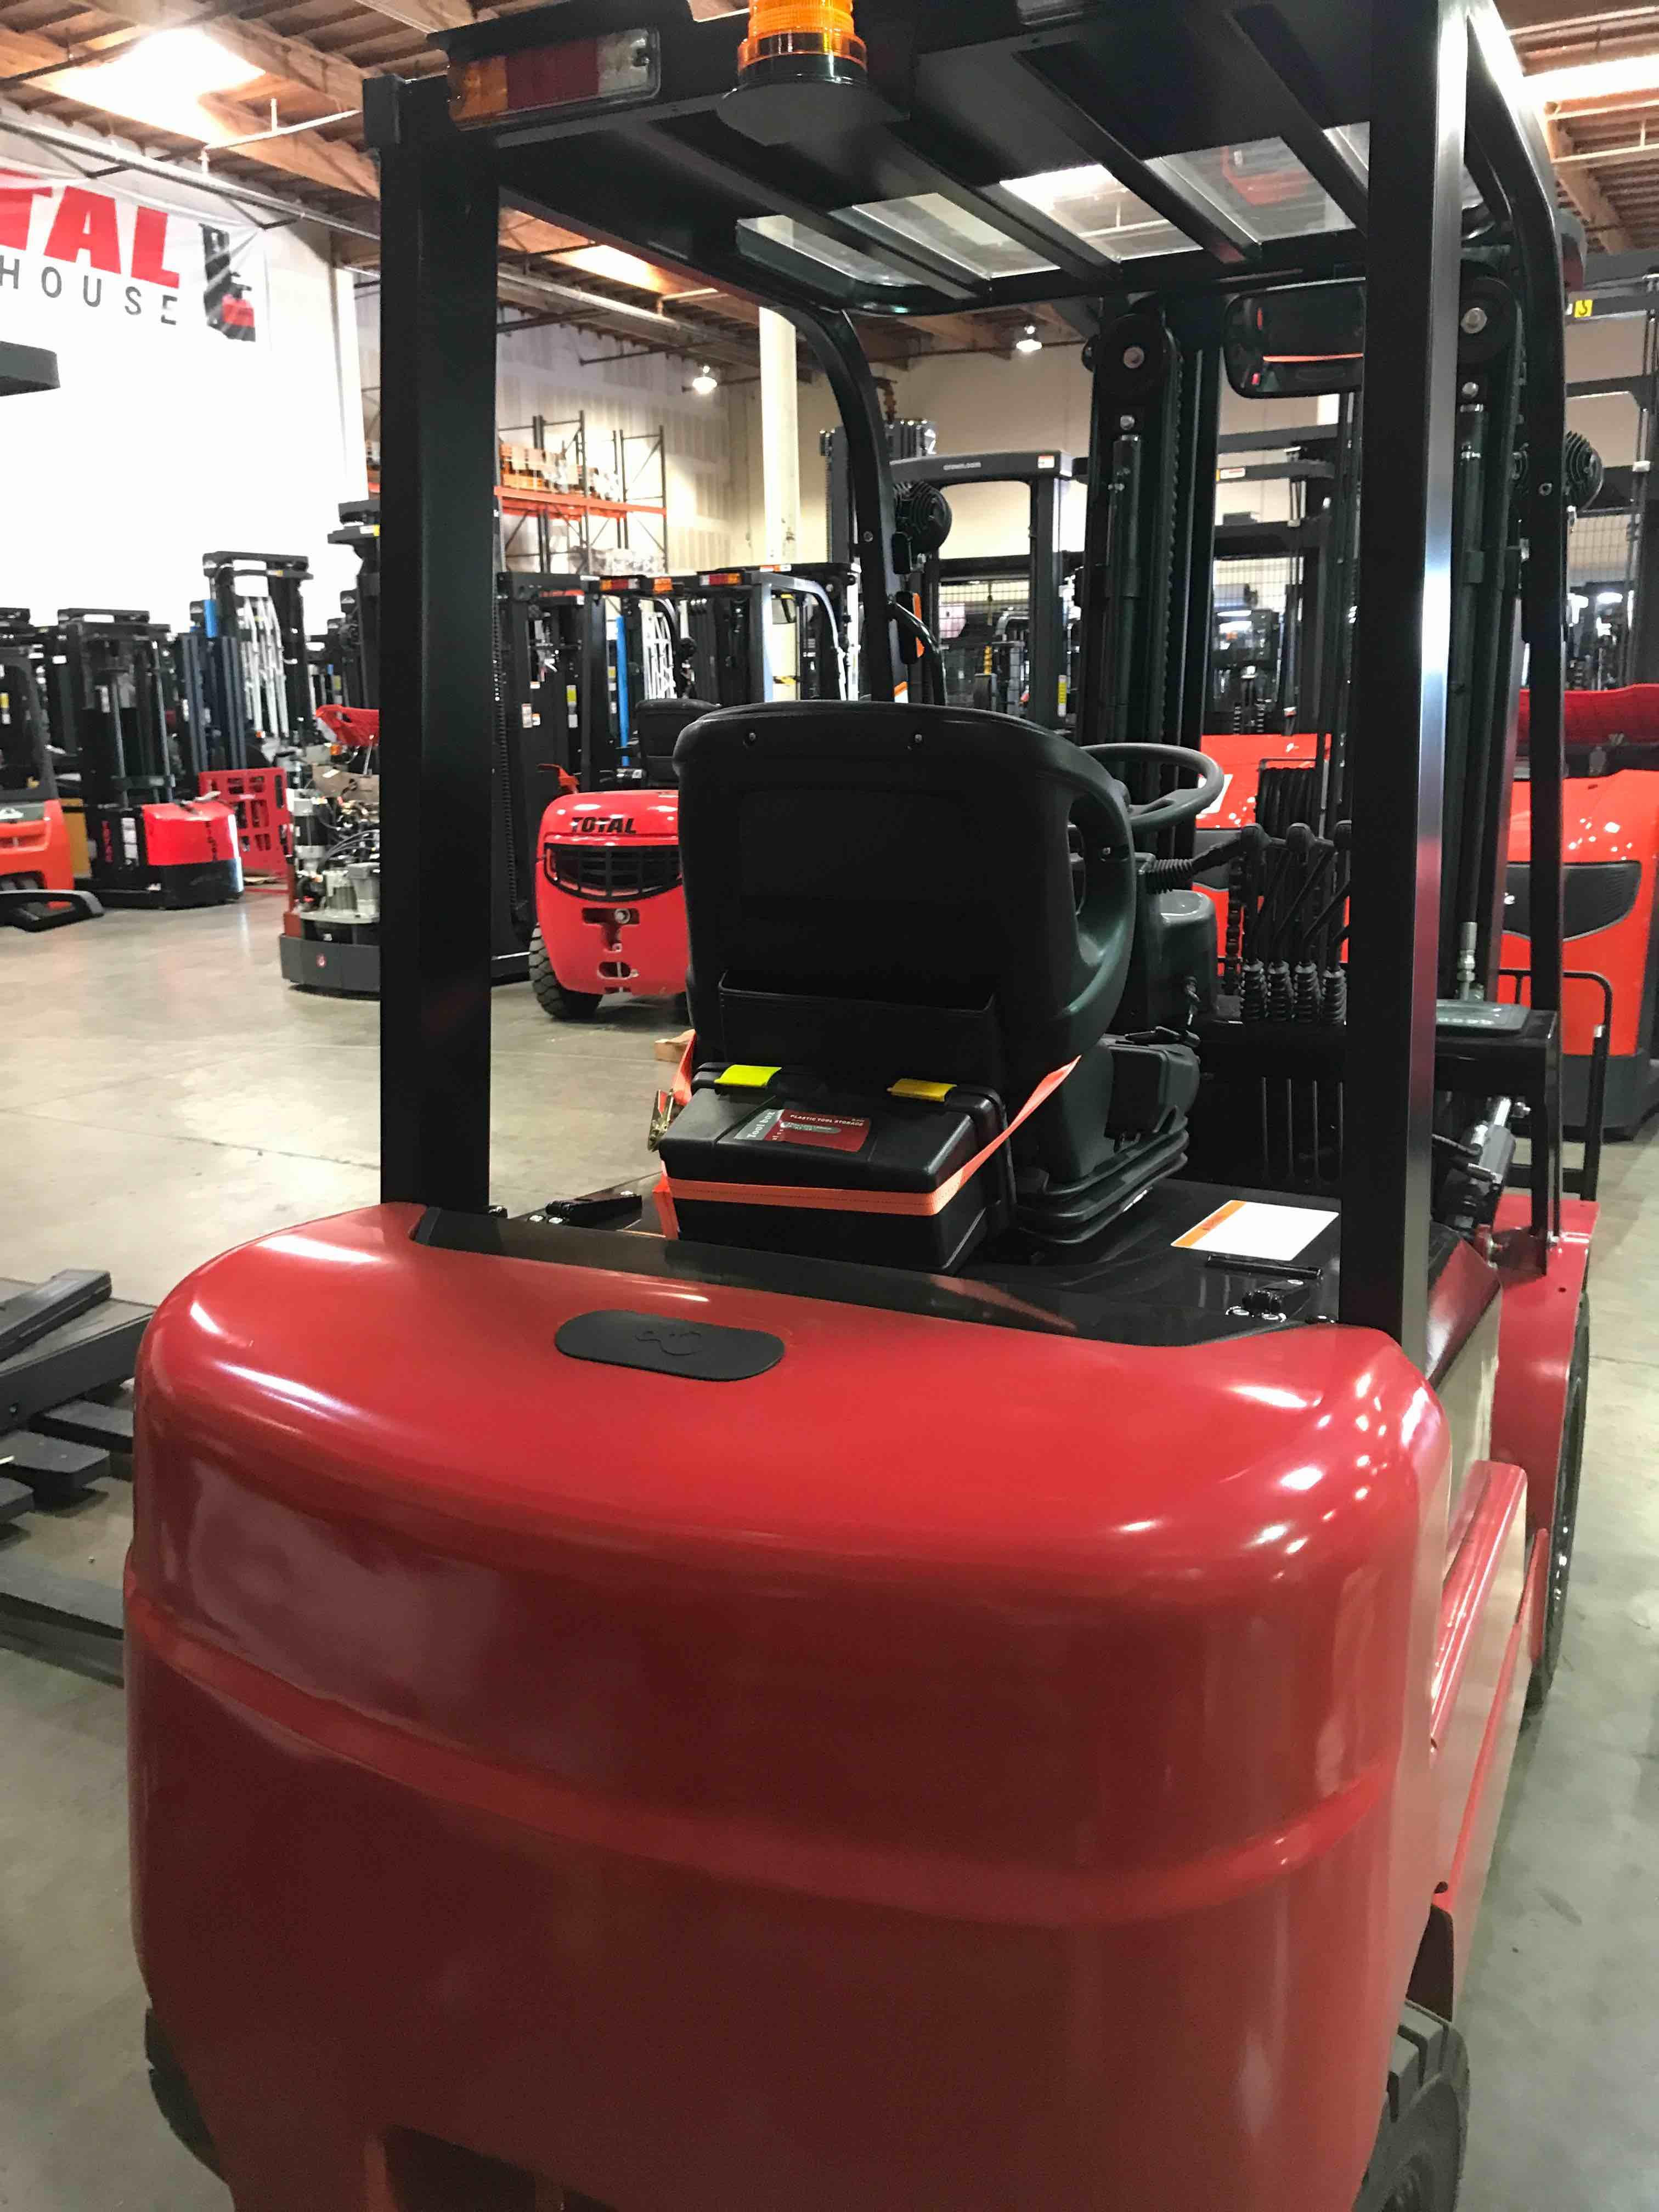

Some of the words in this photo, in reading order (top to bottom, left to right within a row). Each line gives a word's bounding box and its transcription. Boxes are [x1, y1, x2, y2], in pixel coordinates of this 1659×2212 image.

[571, 816, 636, 833] TOTAL
[746, 1124, 765, 1138] Tool
[759, 1111, 775, 1123] box
